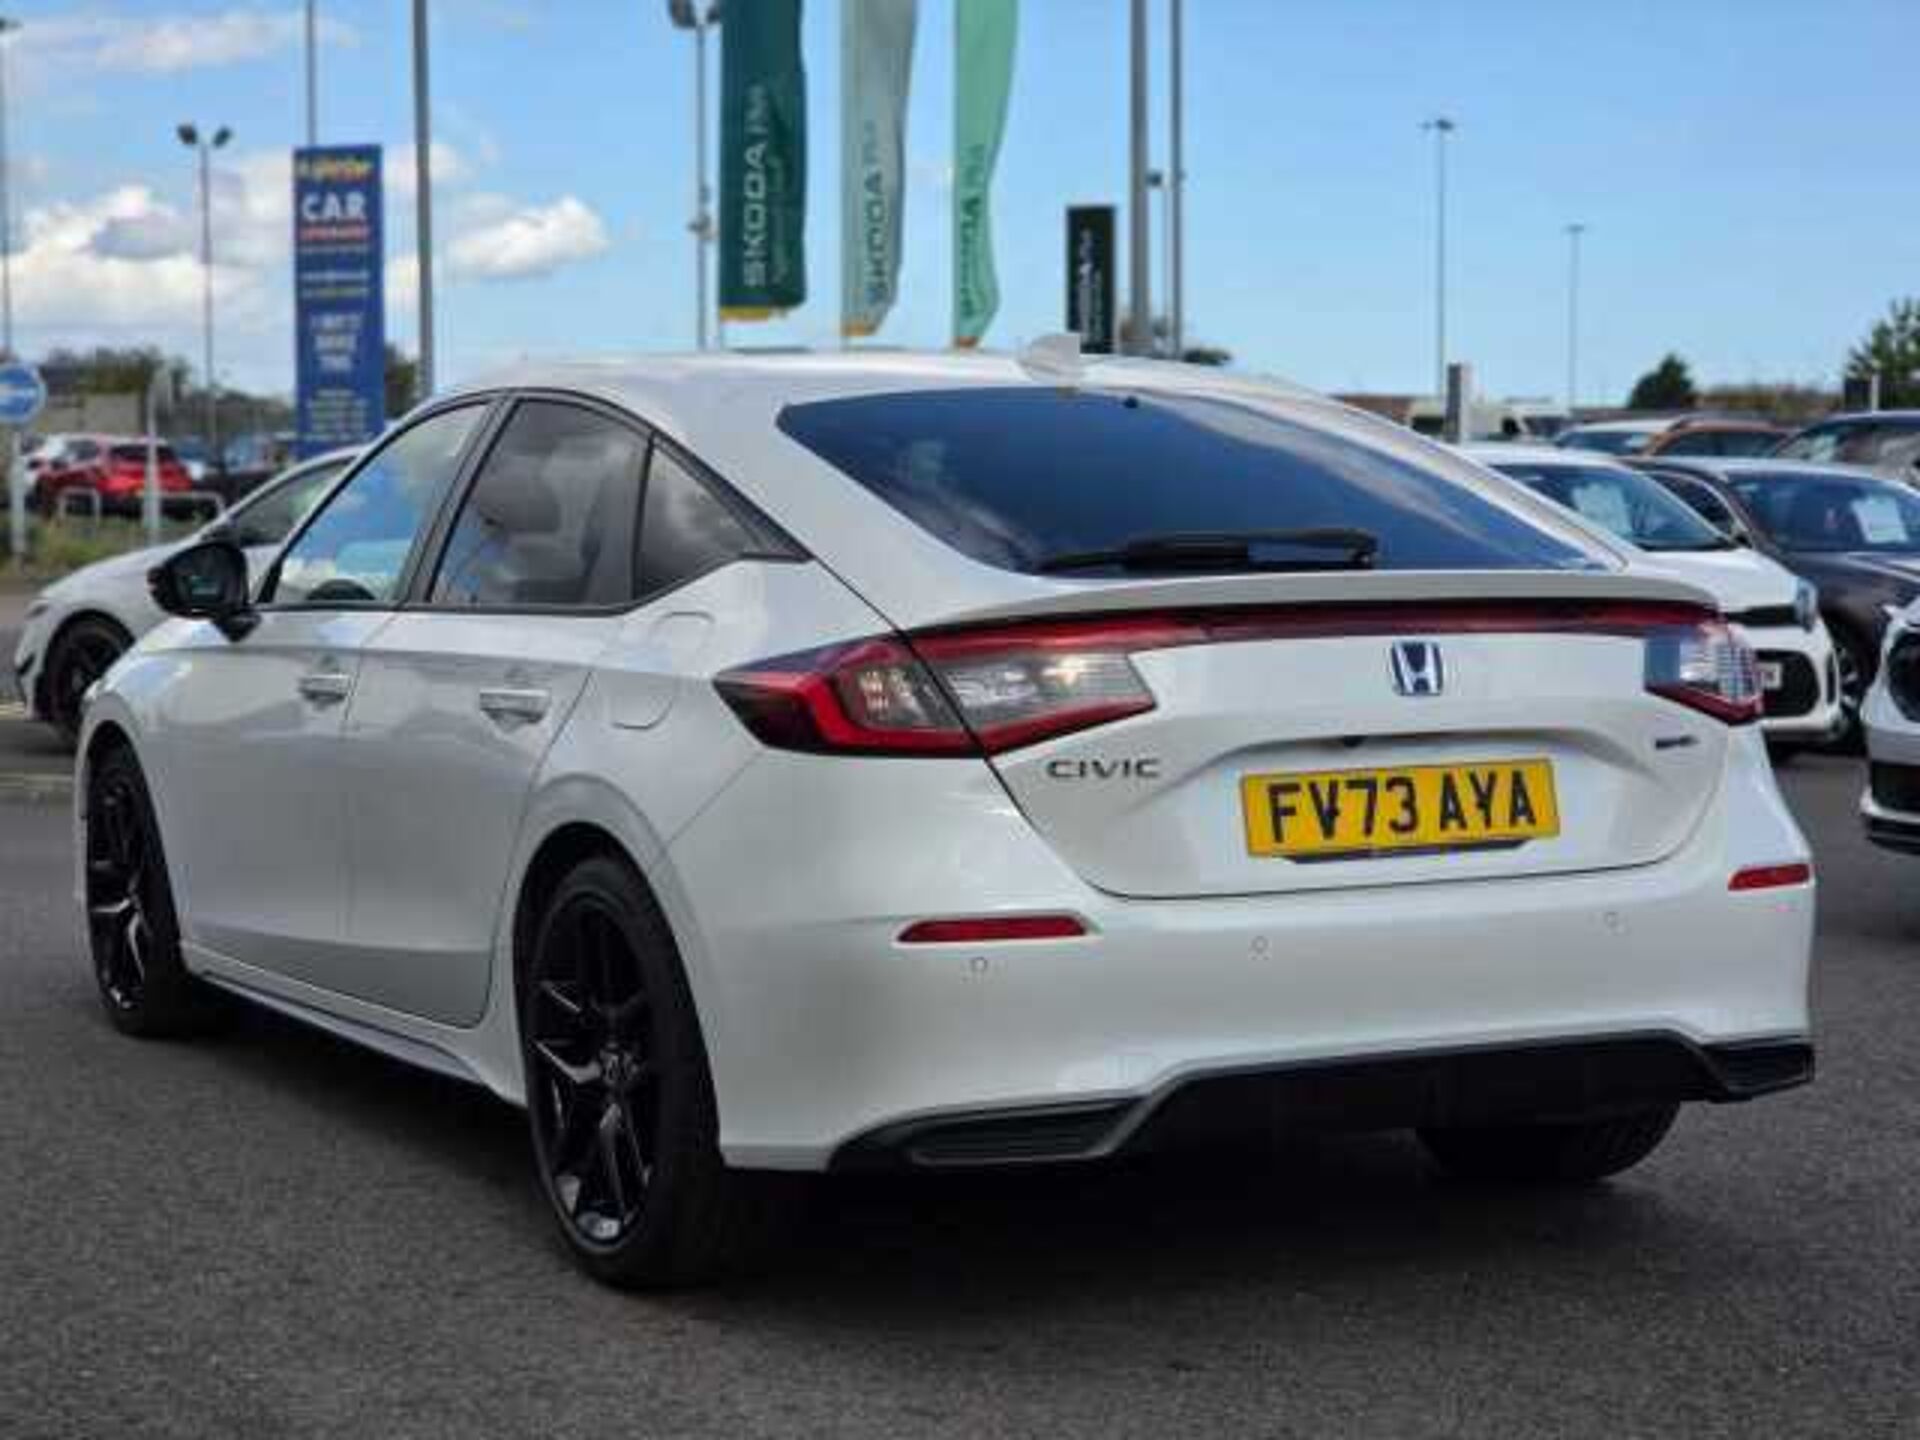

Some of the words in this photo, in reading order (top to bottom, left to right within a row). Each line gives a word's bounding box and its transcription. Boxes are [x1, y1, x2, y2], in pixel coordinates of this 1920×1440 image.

[302, 191, 367, 222] CAR
[1046, 758, 1160, 779] CIVIC
[1267, 776, 1420, 844] FV73
[1439, 770, 1537, 831] AYA
